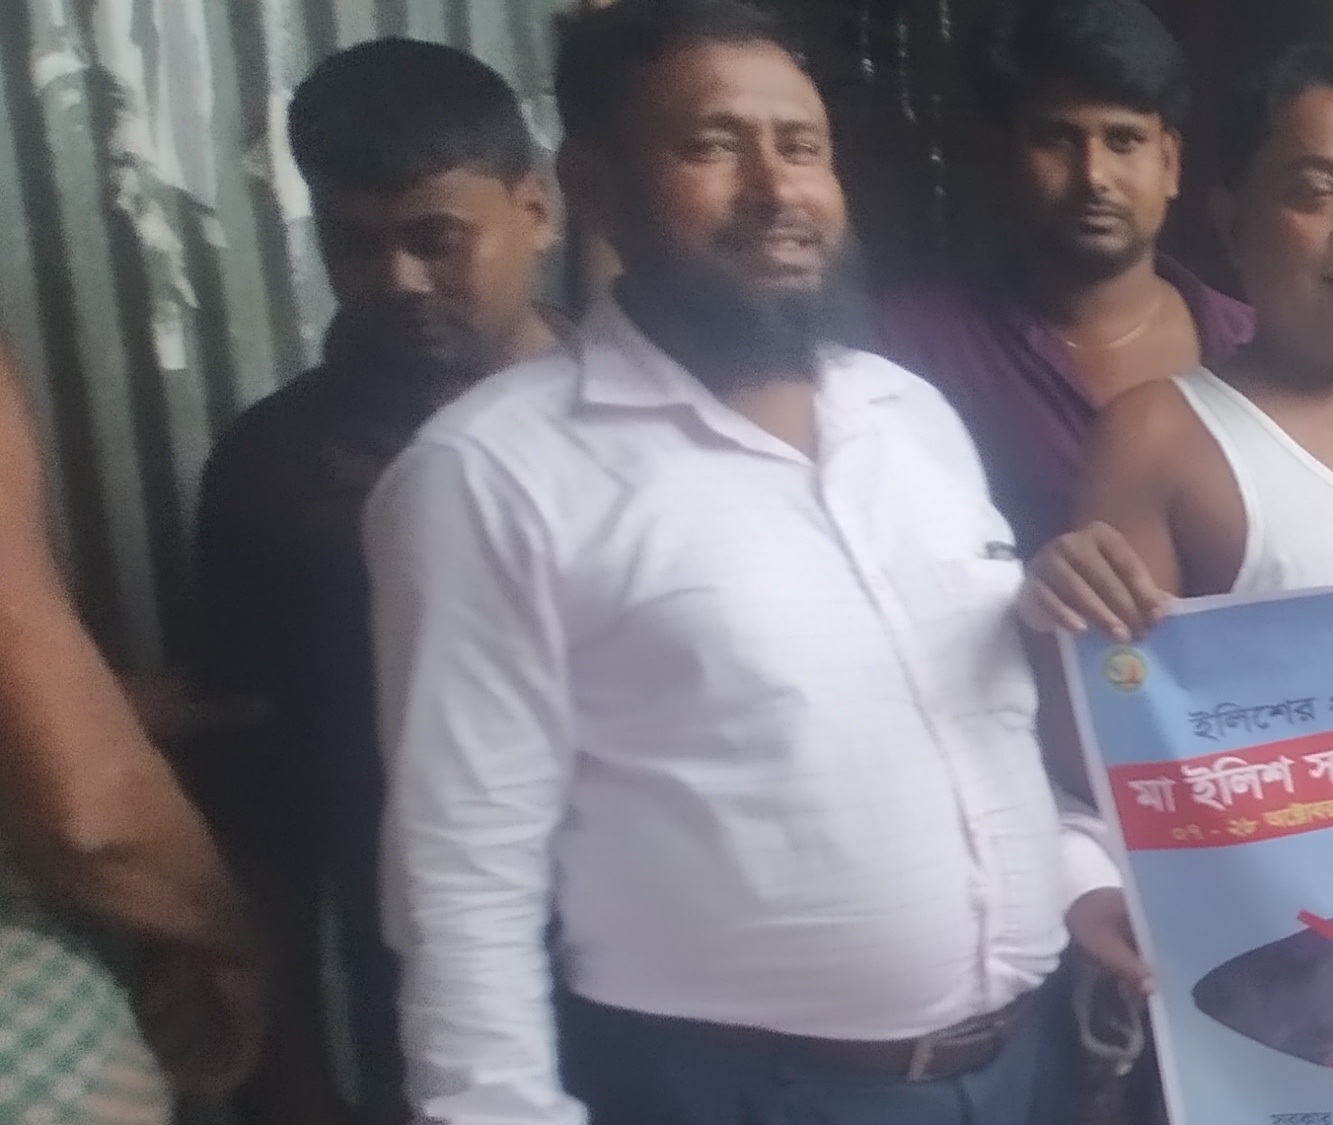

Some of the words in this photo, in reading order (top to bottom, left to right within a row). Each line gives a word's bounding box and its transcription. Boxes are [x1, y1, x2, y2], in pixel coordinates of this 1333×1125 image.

[1187, 696, 1316, 741] ইলিশের
[1126, 776, 1176, 812] মা
[1180, 755, 1295, 810] ইলিশ
